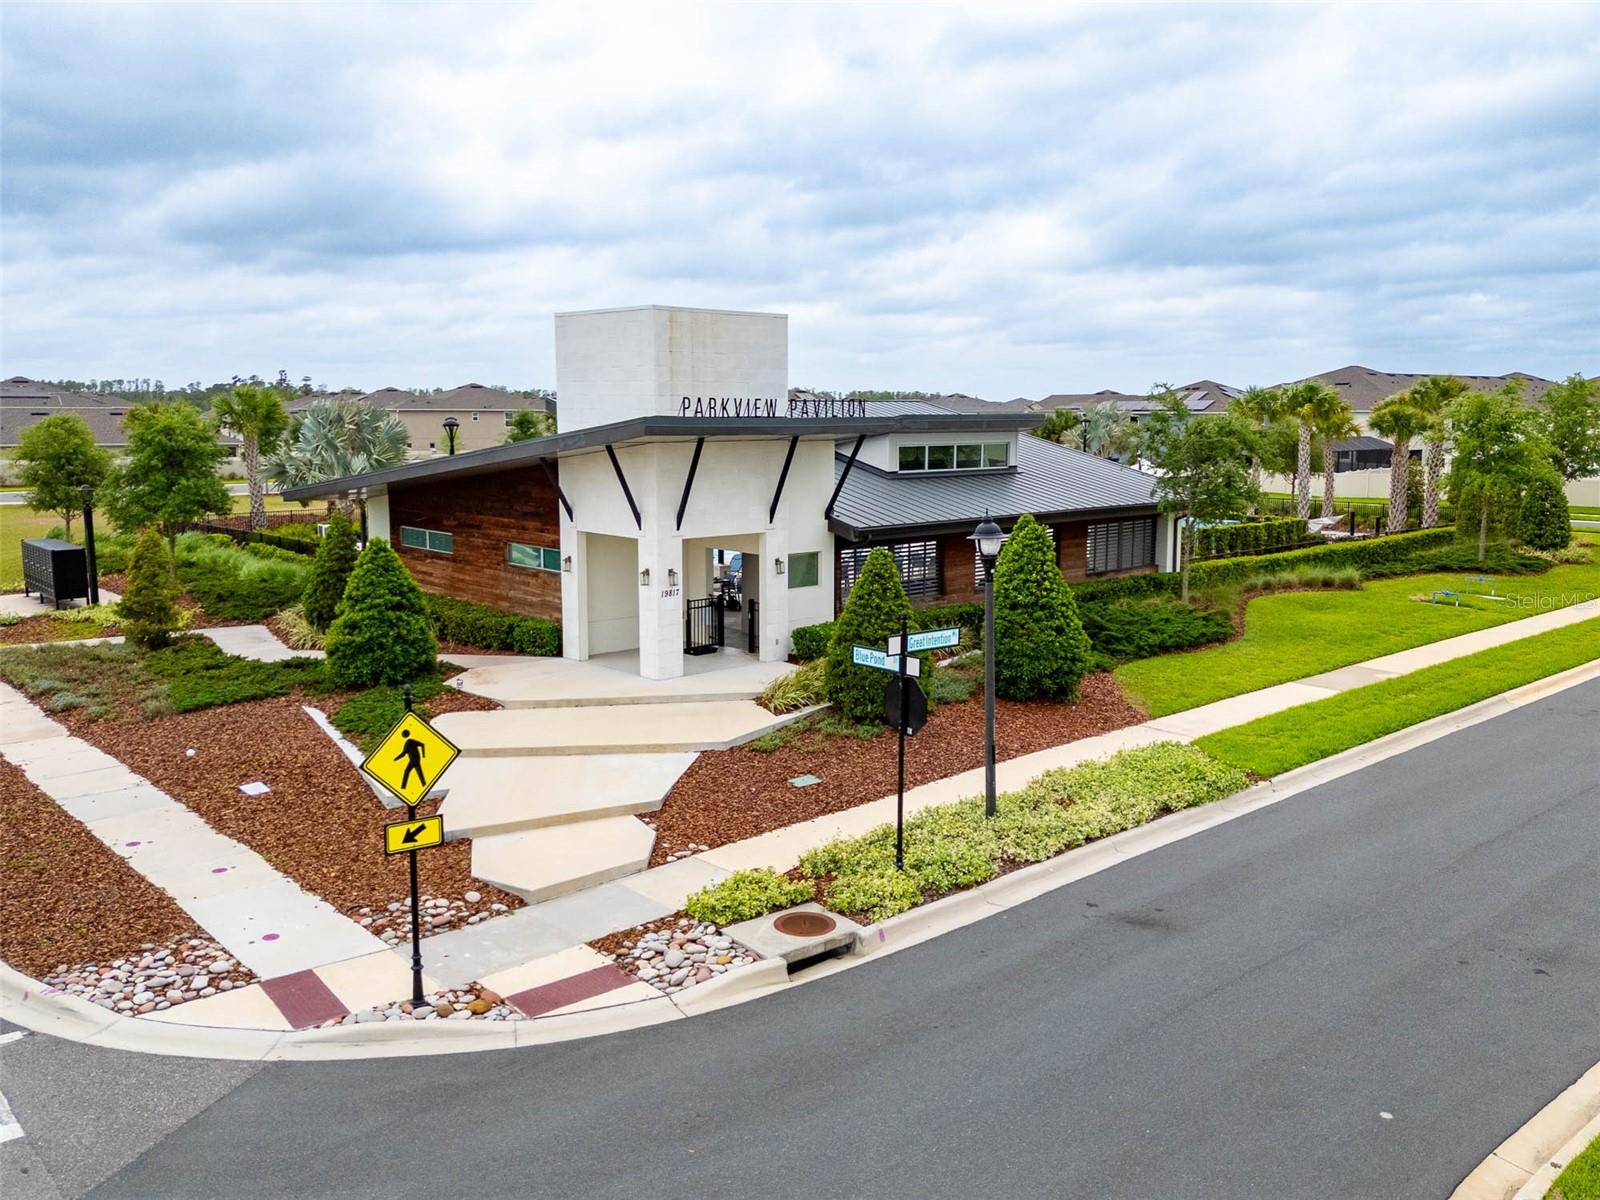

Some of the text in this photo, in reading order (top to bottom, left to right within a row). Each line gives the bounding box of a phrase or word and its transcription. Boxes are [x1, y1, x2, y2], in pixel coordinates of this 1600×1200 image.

[681, 396, 866, 418] PARKVIEW PAVILION
[661, 588, 680, 598] 19817
[909, 636, 925, 649] Great
[926, 633, 951, 646] Intention
[855, 648, 869, 663] Blue
[869, 651, 886, 666] Pond
